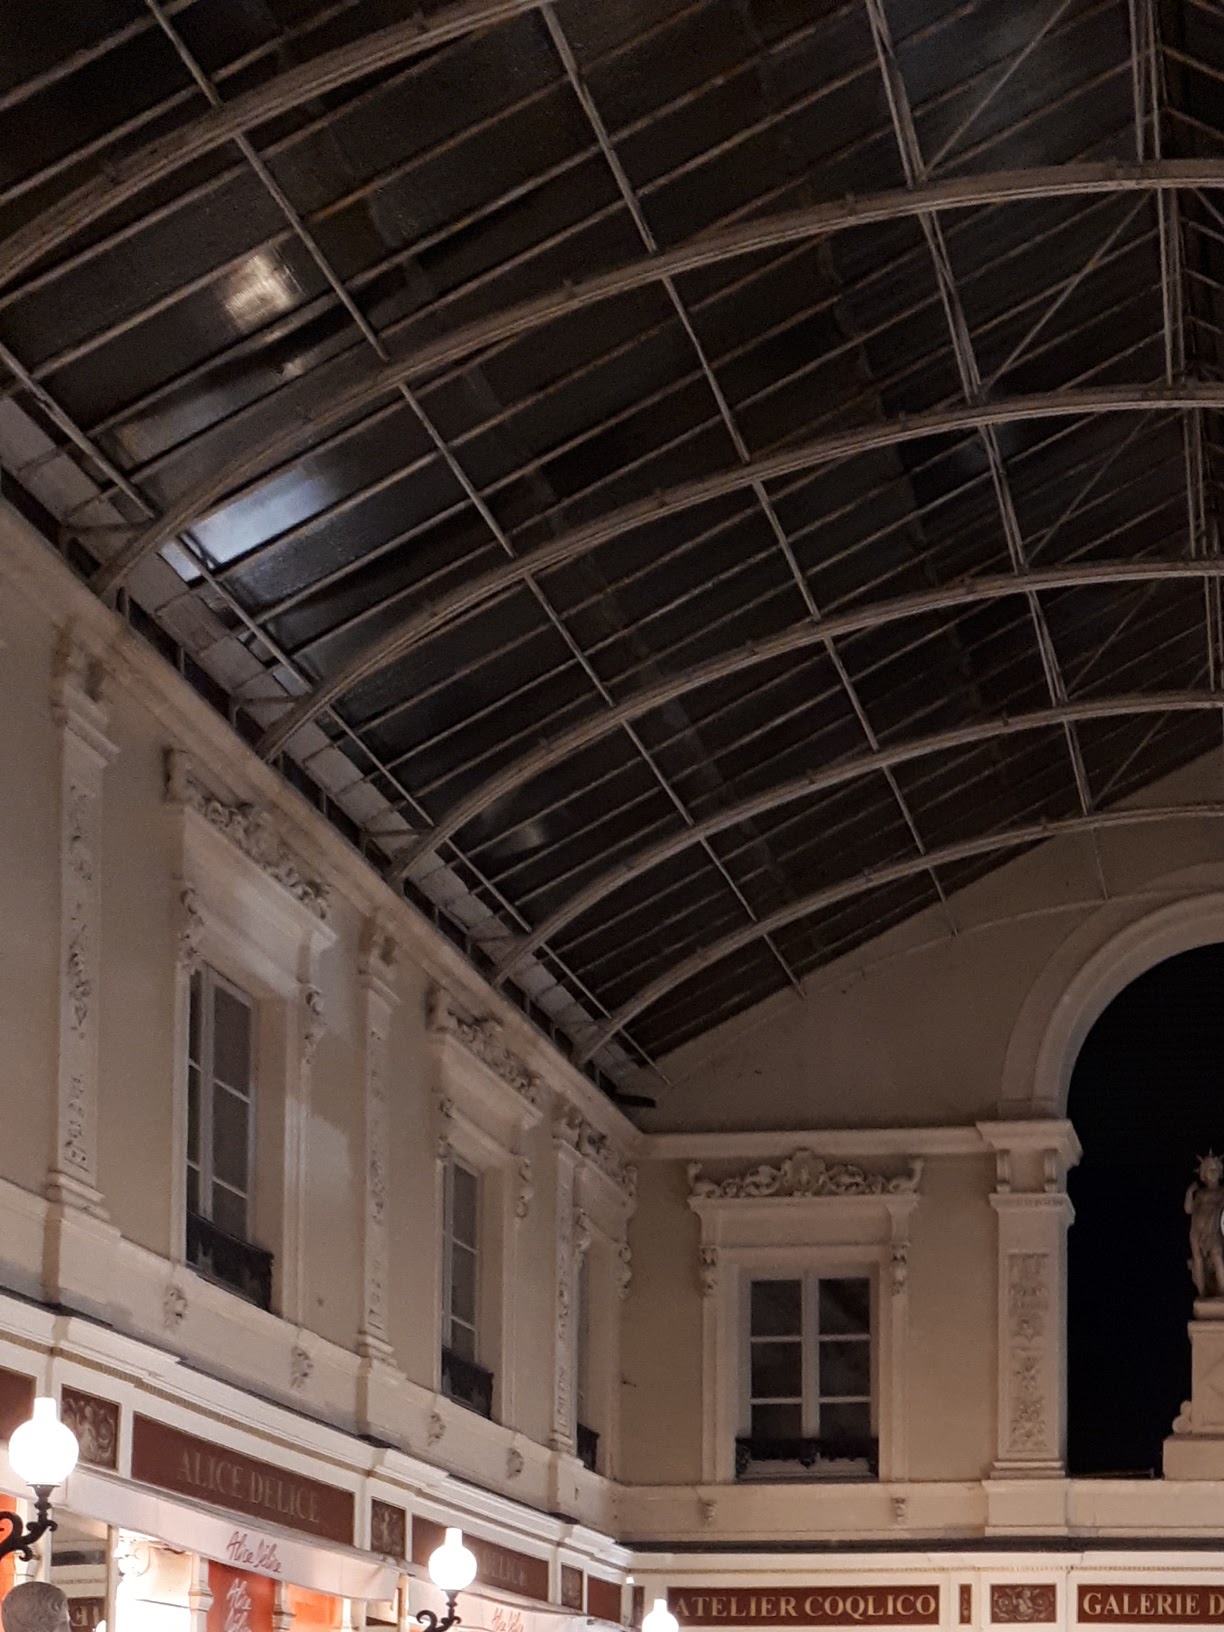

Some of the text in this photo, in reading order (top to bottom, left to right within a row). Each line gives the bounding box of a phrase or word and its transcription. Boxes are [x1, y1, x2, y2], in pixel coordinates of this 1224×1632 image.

[176, 1451, 320, 1523] ALICE DELICE
[675, 1593, 936, 1620] ATELIER COQLICO
[1083, 1592, 1201, 1616] GALERIE
